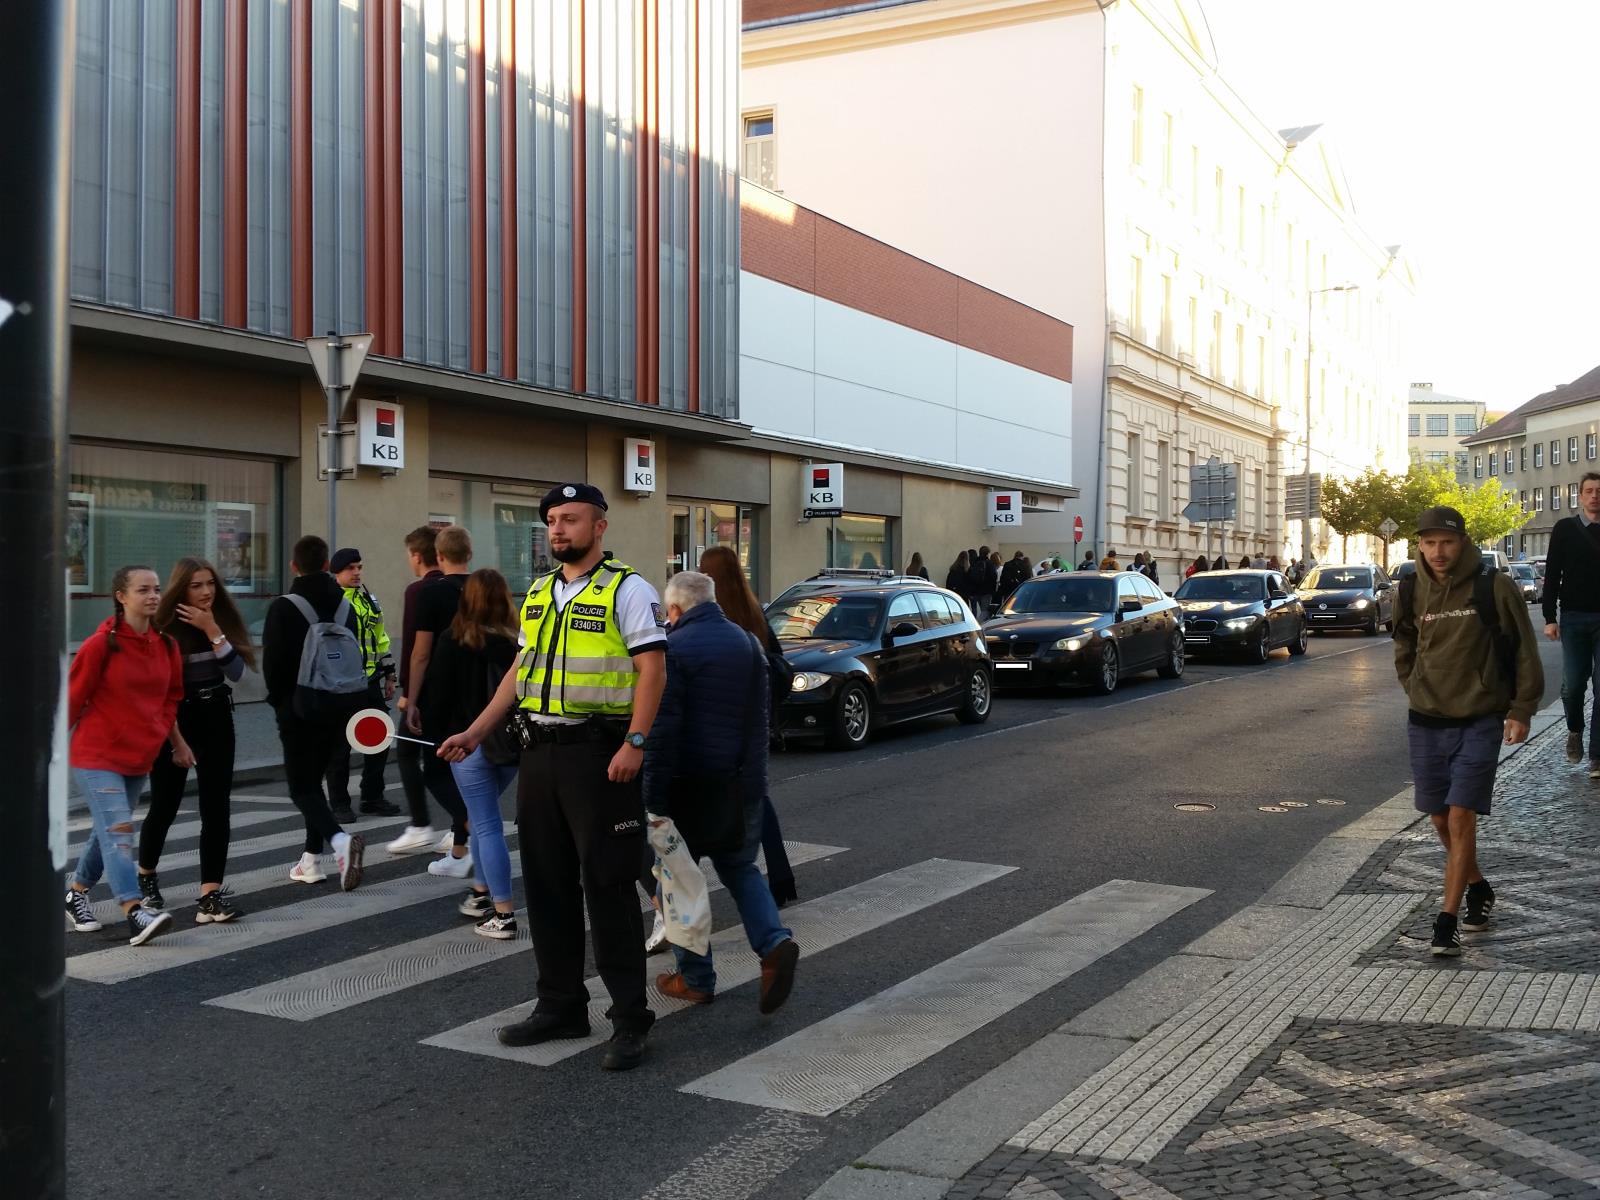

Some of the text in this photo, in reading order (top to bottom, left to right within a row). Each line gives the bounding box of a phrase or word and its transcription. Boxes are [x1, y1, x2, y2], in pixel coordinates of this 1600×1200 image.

[372, 443, 398, 460] KB
[634, 473, 652, 485] KB
[810, 492, 834, 504] KB
[993, 514, 1014, 523] KB
[572, 604, 605, 617] POLICIE
[573, 619, 602, 631] 334053
